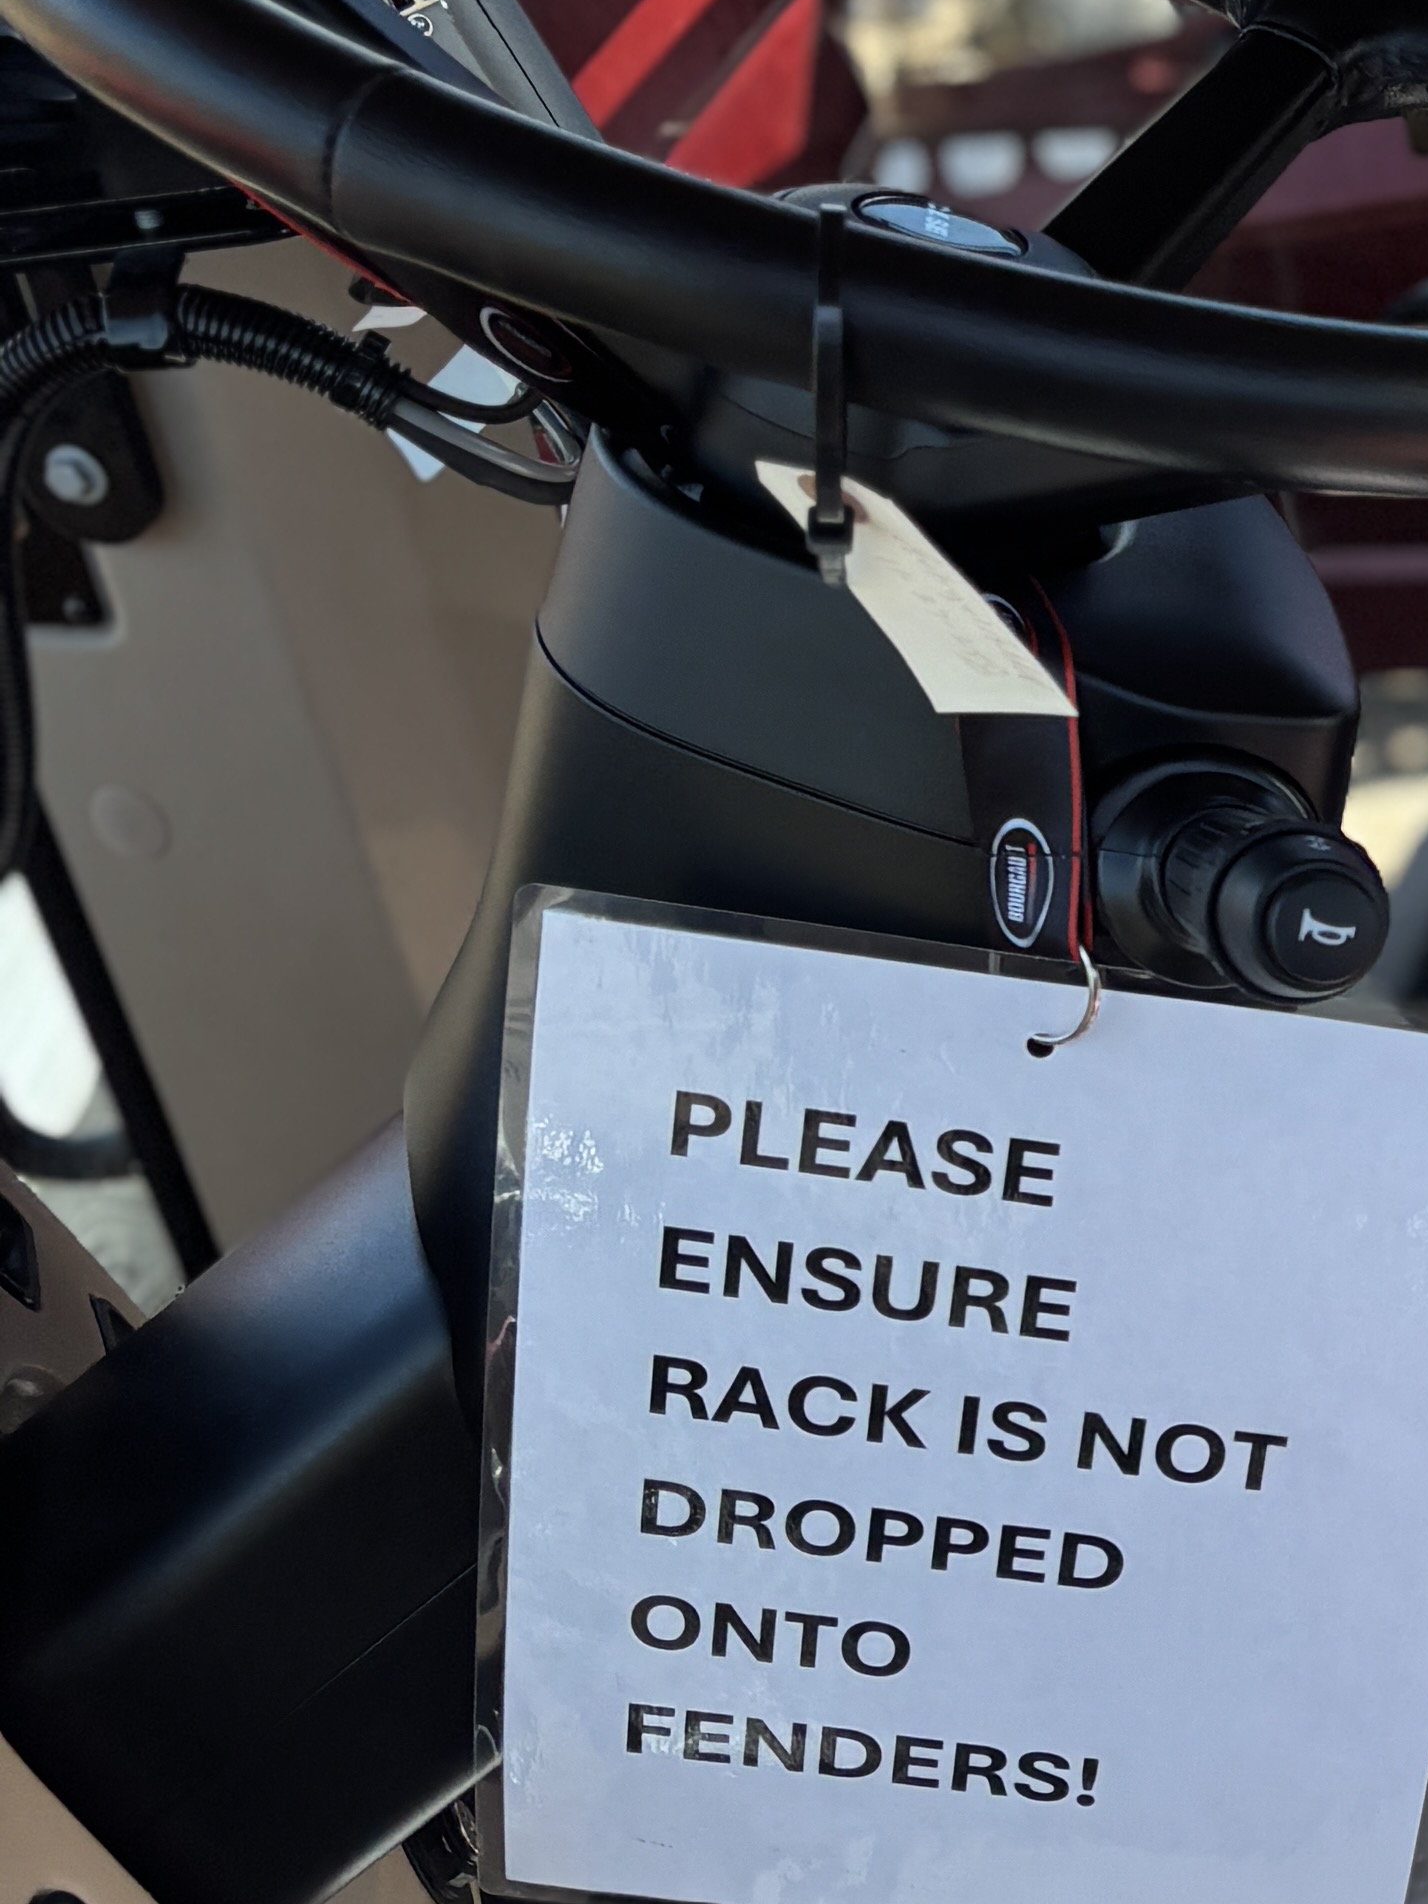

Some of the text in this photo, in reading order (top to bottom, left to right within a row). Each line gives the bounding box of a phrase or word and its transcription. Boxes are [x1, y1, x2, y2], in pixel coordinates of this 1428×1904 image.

[1004, 843, 1028, 924] BOURGAUT
[670, 1090, 1061, 1207] PLEASE
[658, 1225, 1077, 1342] ENSURE
[649, 1354, 1289, 1491] RACK IS NOT
[640, 1478, 1124, 1589] DROPPED
[630, 1595, 911, 1677] ONTO
[626, 1702, 1099, 1807] FENDERS!
